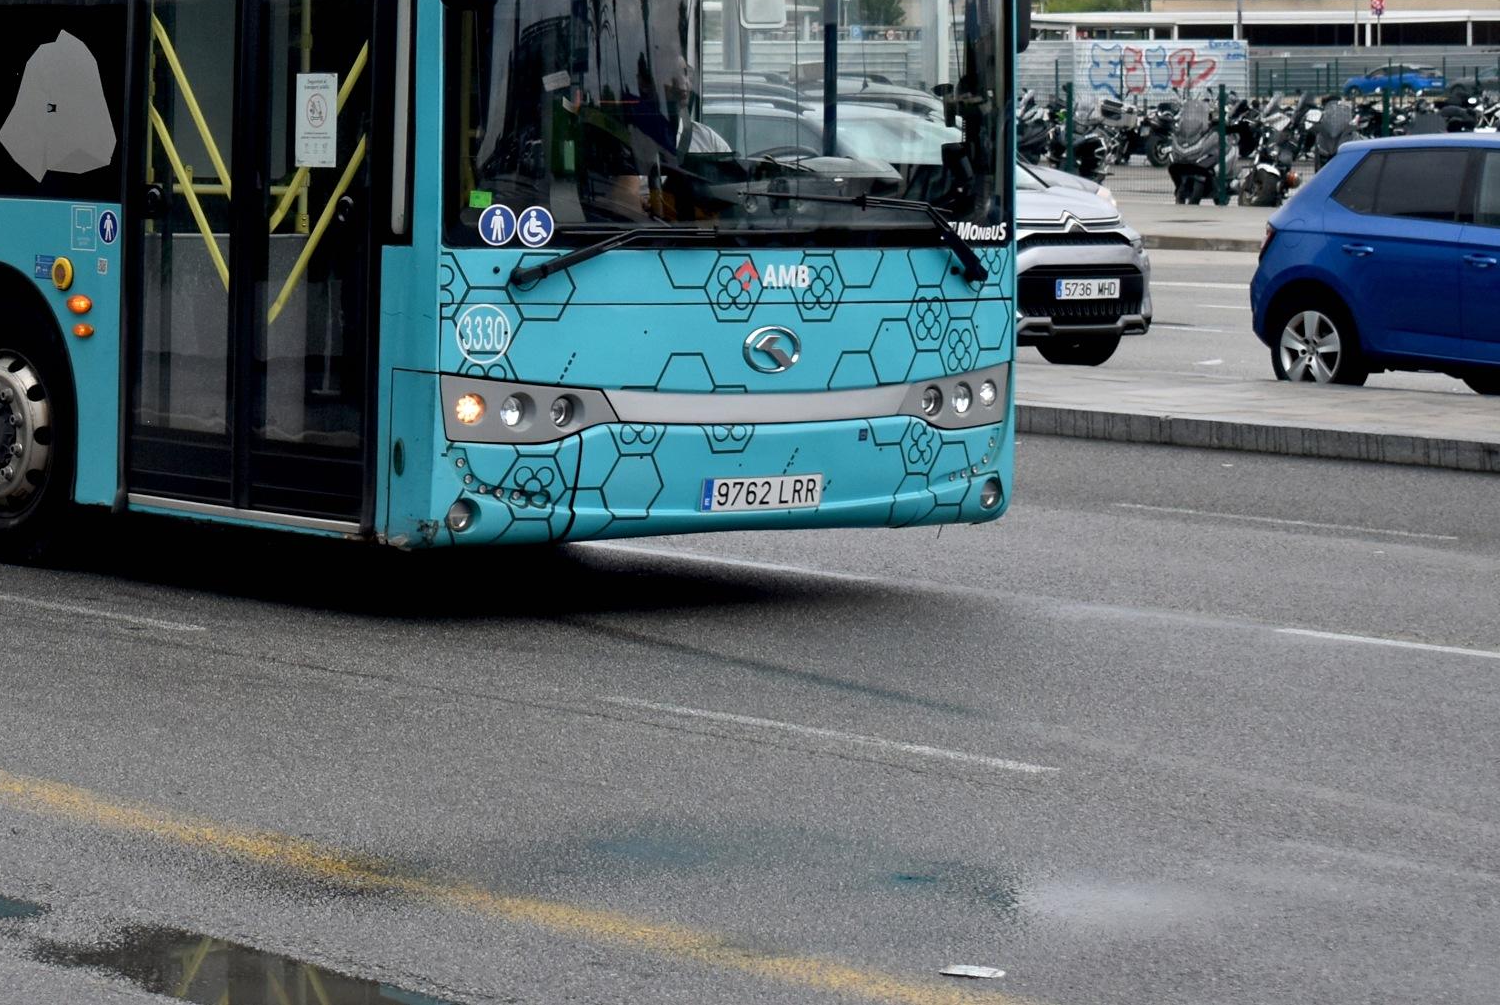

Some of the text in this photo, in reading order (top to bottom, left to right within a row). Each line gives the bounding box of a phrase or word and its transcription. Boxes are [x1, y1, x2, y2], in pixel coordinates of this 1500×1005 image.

[762, 264, 811, 288] AMB
[1064, 282, 1092, 297] 5736
[462, 315, 505, 350] 3330
[716, 480, 772, 507] 9762
[778, 478, 817, 504] LRR
